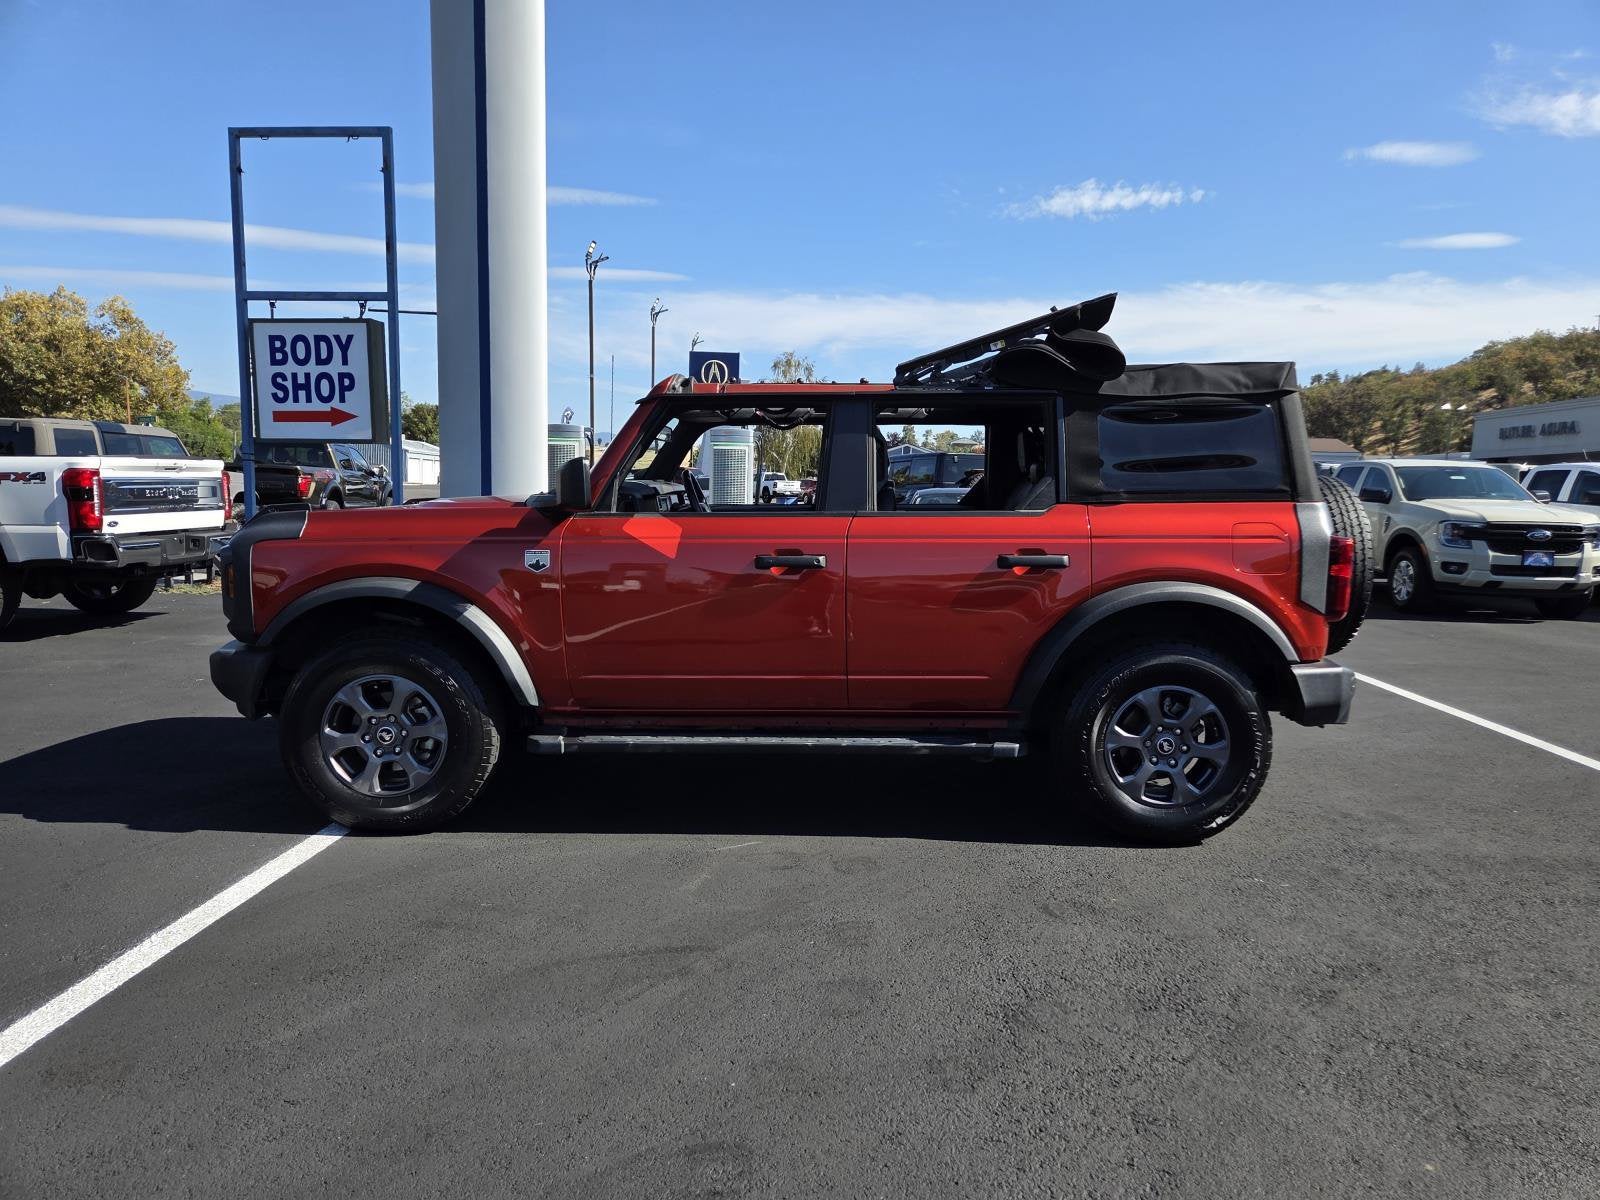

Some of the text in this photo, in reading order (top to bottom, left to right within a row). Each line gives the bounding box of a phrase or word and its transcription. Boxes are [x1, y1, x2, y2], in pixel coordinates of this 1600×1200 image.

[268, 334, 354, 366] BODY
[270, 371, 355, 404] SHOP
[1539, 420, 1581, 437] ACURA
